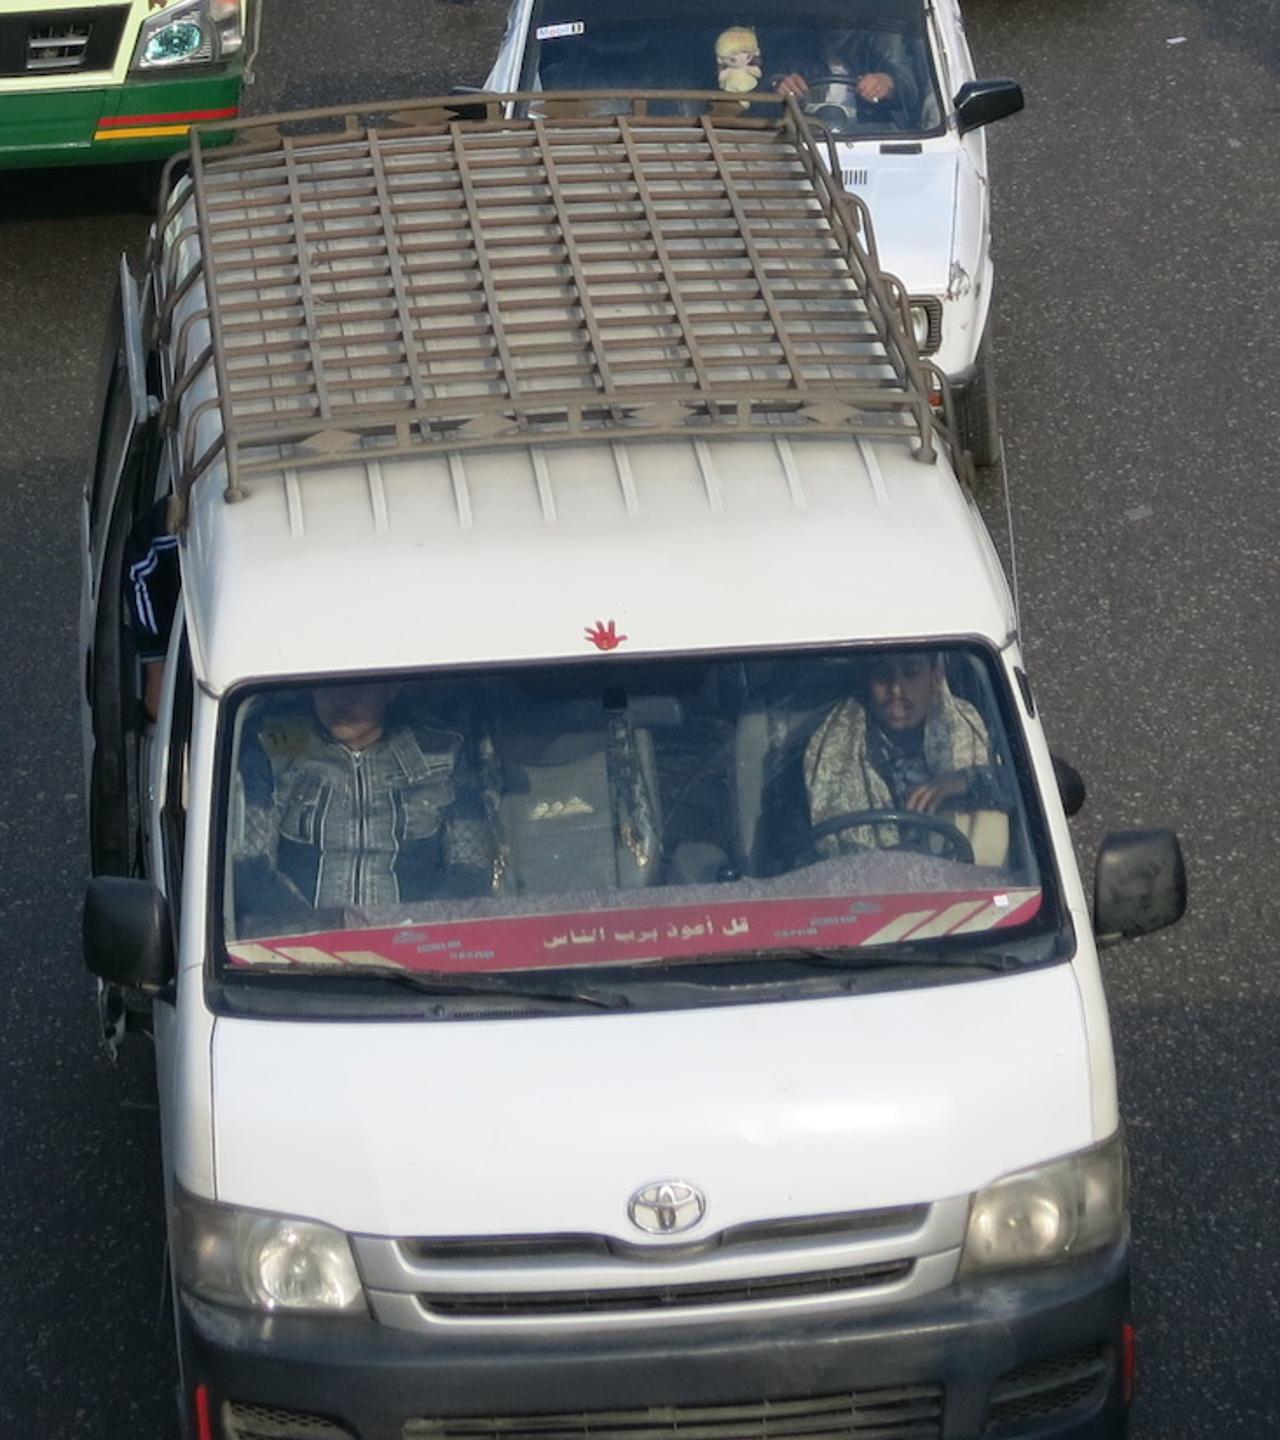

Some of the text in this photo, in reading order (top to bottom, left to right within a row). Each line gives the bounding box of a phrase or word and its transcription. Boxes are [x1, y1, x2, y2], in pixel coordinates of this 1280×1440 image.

[614, 927, 658, 944] برب
[666, 914, 715, 941] أعوذ
[722, 916, 750, 937] قل
[543, 927, 605, 949] الناس
